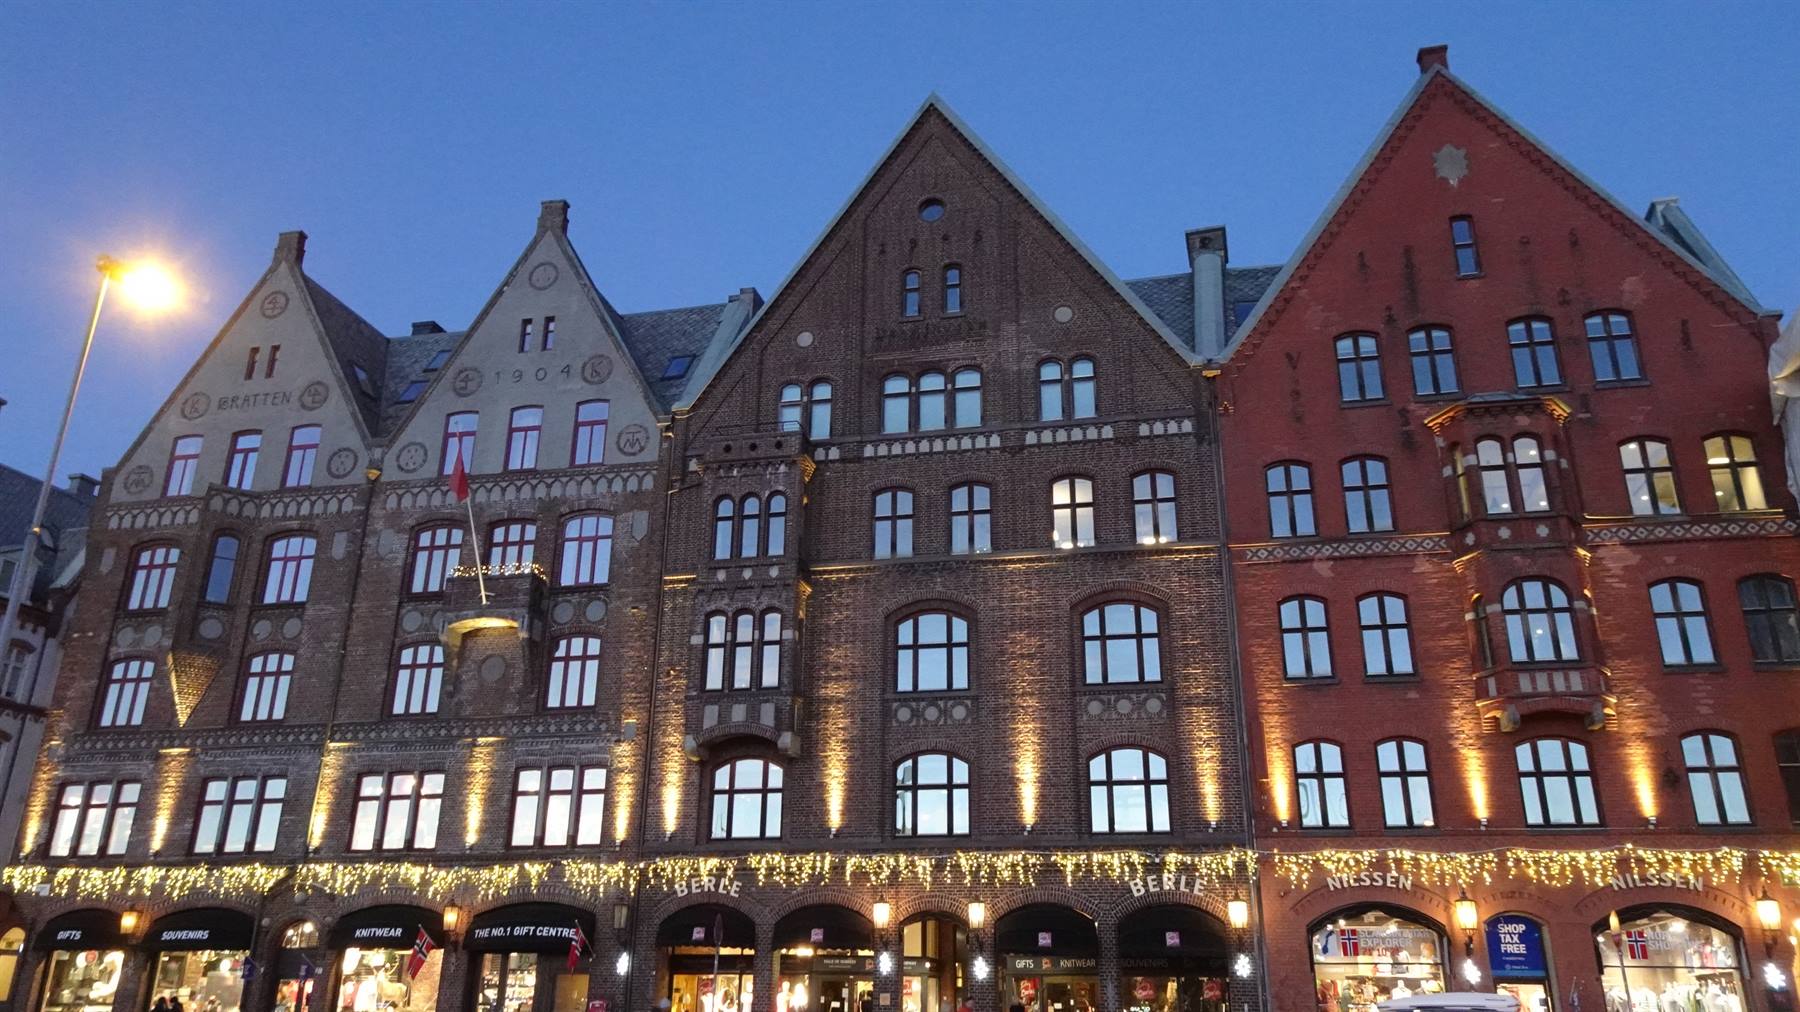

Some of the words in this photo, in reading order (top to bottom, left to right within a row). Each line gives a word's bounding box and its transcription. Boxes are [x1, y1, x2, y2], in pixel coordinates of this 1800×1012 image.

[494, 363, 572, 384] 1904
[674, 876, 743, 898] BERLE
[1129, 873, 1207, 898] BERLE
[1327, 872, 1413, 892] NILSSEN
[1611, 872, 1704, 892] NILSSEN
[354, 927, 403, 938] KNITWEAR
[474, 929, 490, 939] THE
[491, 927, 511, 937] NO.1
[513, 926, 535, 936] GIFT
[536, 926, 577, 938] CENTRE
[1497, 923, 1526, 934] SHOP
[57, 930, 82, 940] GIFTS
[161, 930, 210, 940] SOUVENIRS
[1499, 934, 1520, 943] TAX
[1500, 944, 1527, 954] FREE
[1015, 959, 1034, 969] GIFTS
[1060, 959, 1096, 969] KNITWEAR
